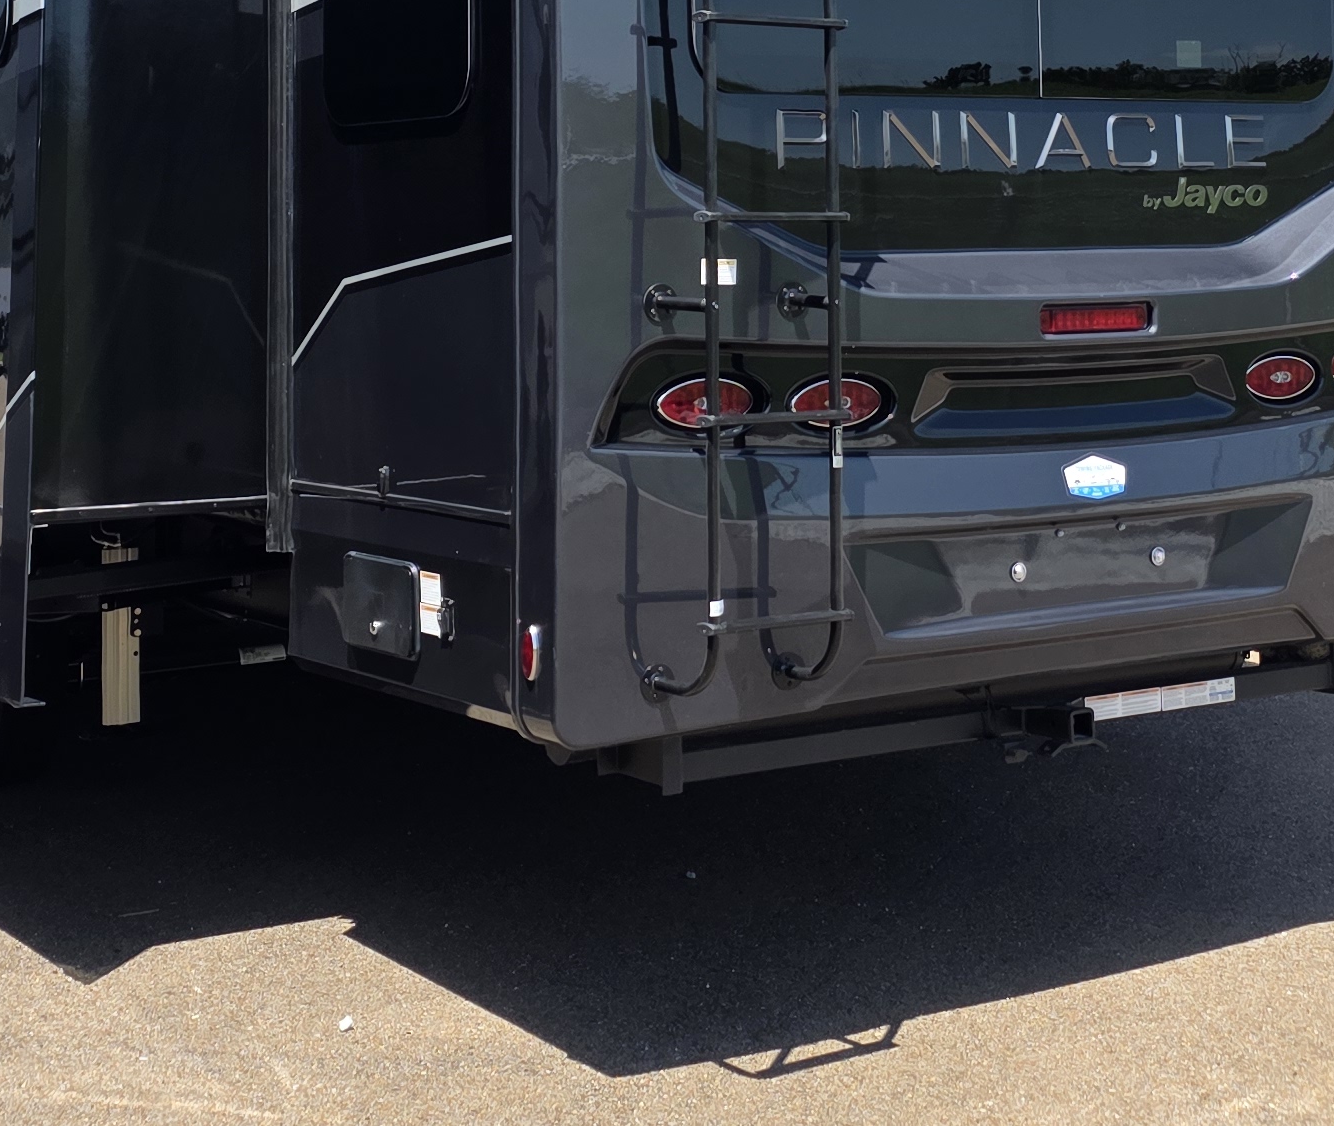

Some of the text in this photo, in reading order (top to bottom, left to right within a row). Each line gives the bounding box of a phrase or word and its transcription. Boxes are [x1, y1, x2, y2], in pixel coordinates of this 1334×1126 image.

[776, 108, 1267, 170] PINNACLE
[1143, 176, 1268, 214] by Jayco
